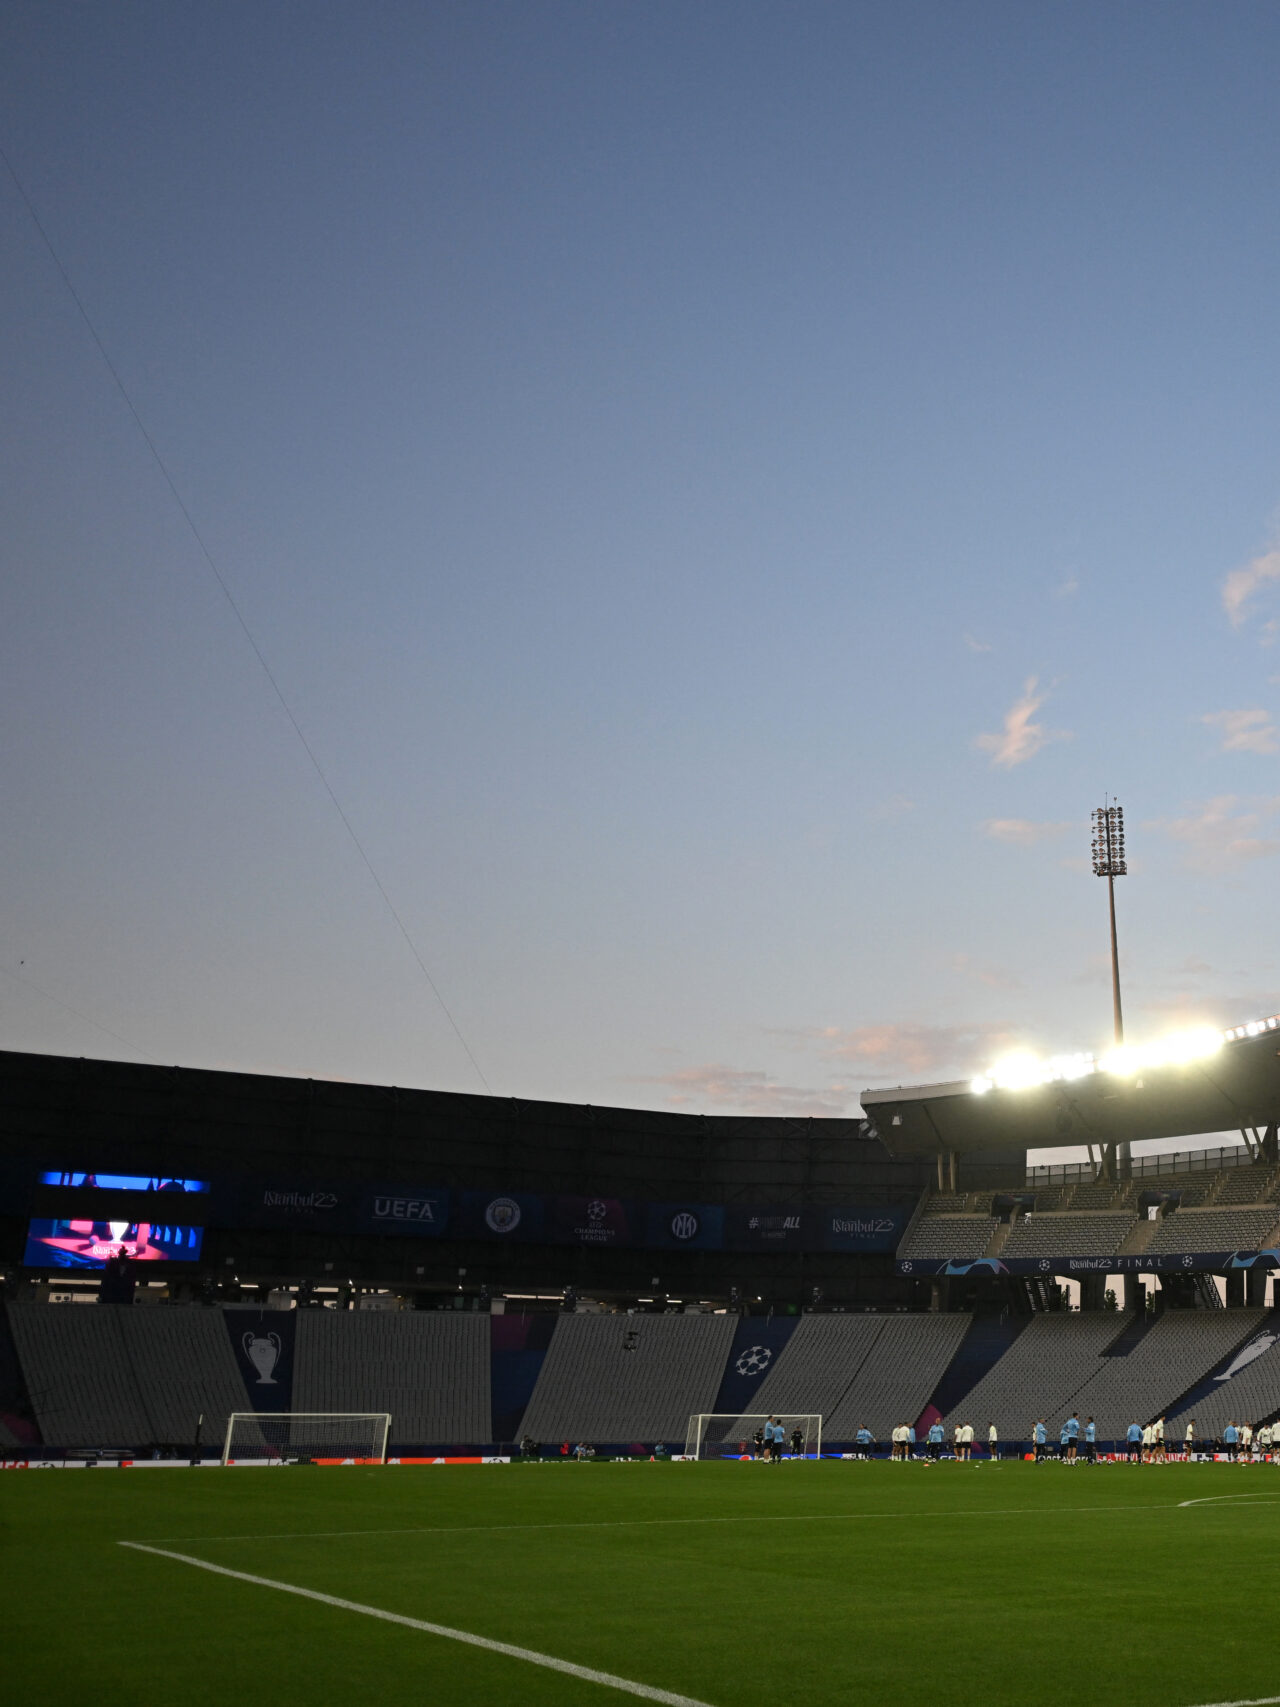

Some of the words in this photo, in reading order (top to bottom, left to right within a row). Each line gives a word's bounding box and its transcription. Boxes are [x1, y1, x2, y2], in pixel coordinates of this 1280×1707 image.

[374, 1200, 434, 1219] UEFA
[574, 1227, 616, 1236] CHAMPIONS
[580, 1234, 608, 1242] LEAGUE
[1117, 1257, 1164, 1268] FINAL
